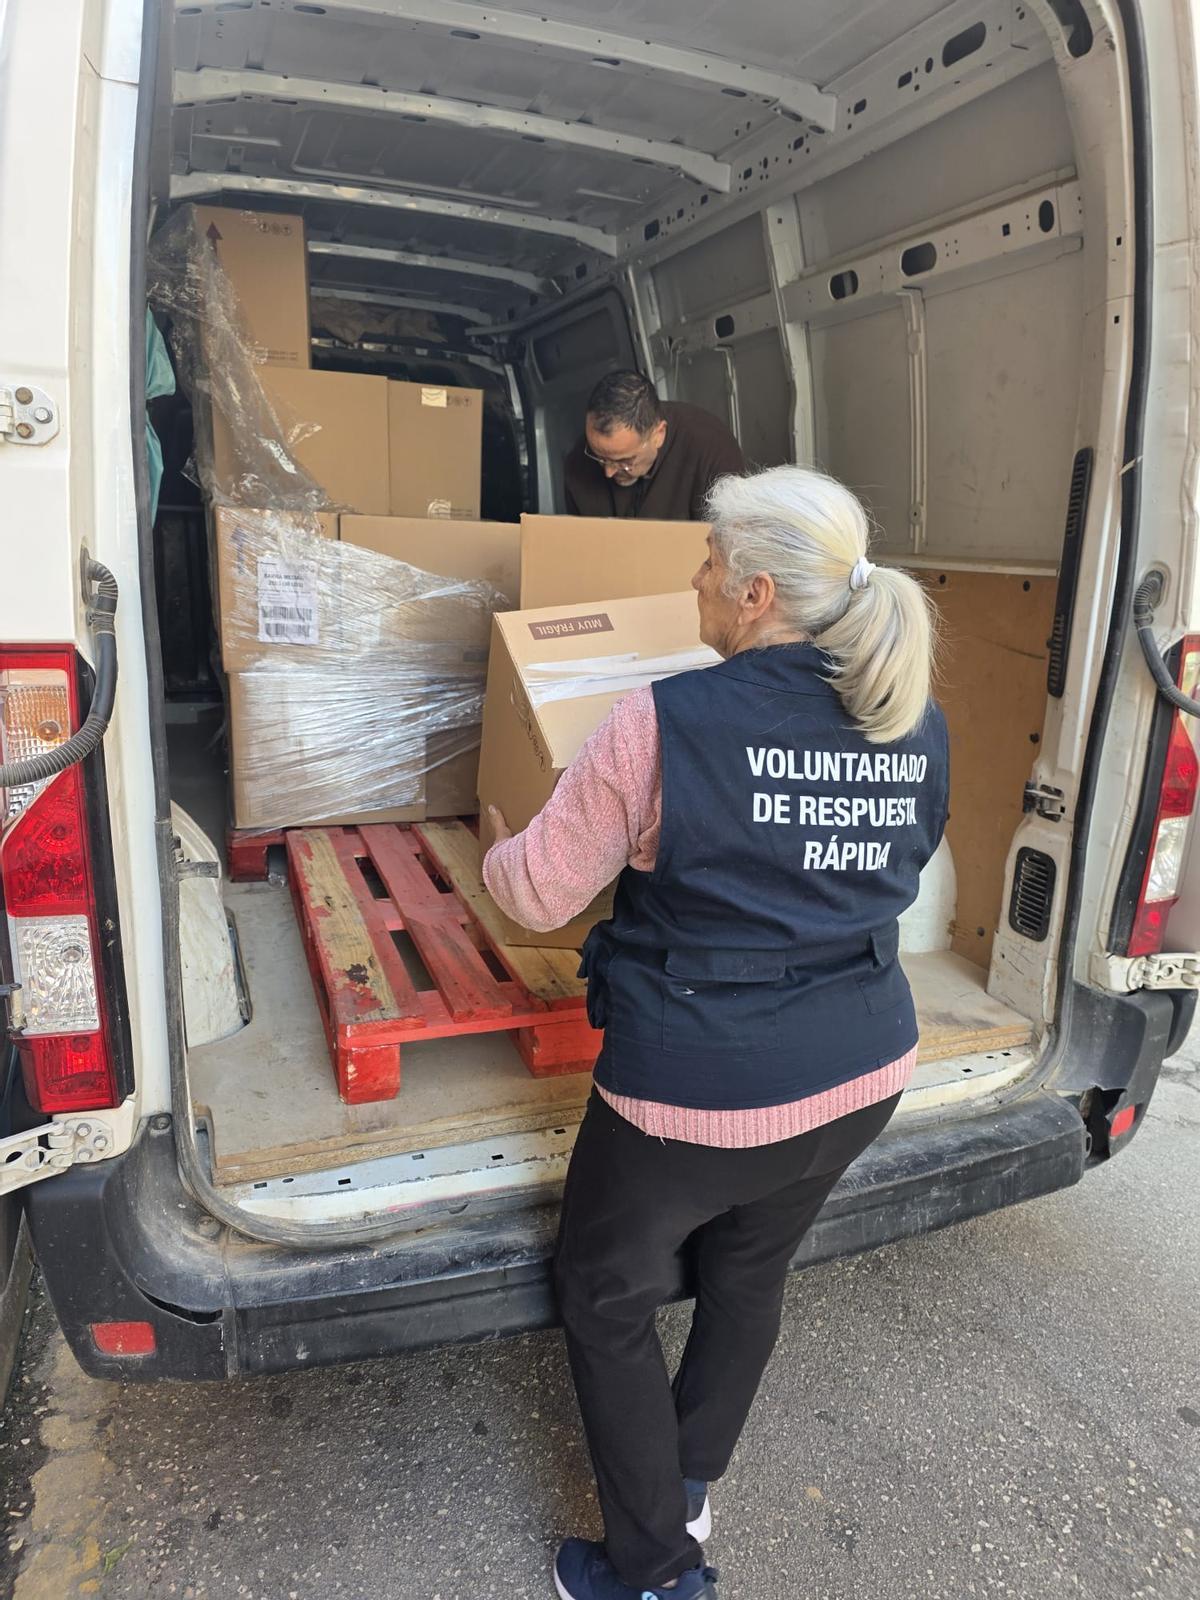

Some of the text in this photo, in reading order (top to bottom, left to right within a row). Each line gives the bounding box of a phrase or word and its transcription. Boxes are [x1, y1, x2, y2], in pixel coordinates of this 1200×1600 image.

[536, 619, 602, 635] MUY FRÁGIL
[746, 747, 927, 783] VOLUNTARIADO
[753, 793, 917, 827] DE RESPUESTA
[803, 835, 891, 871] RÁPIDA
